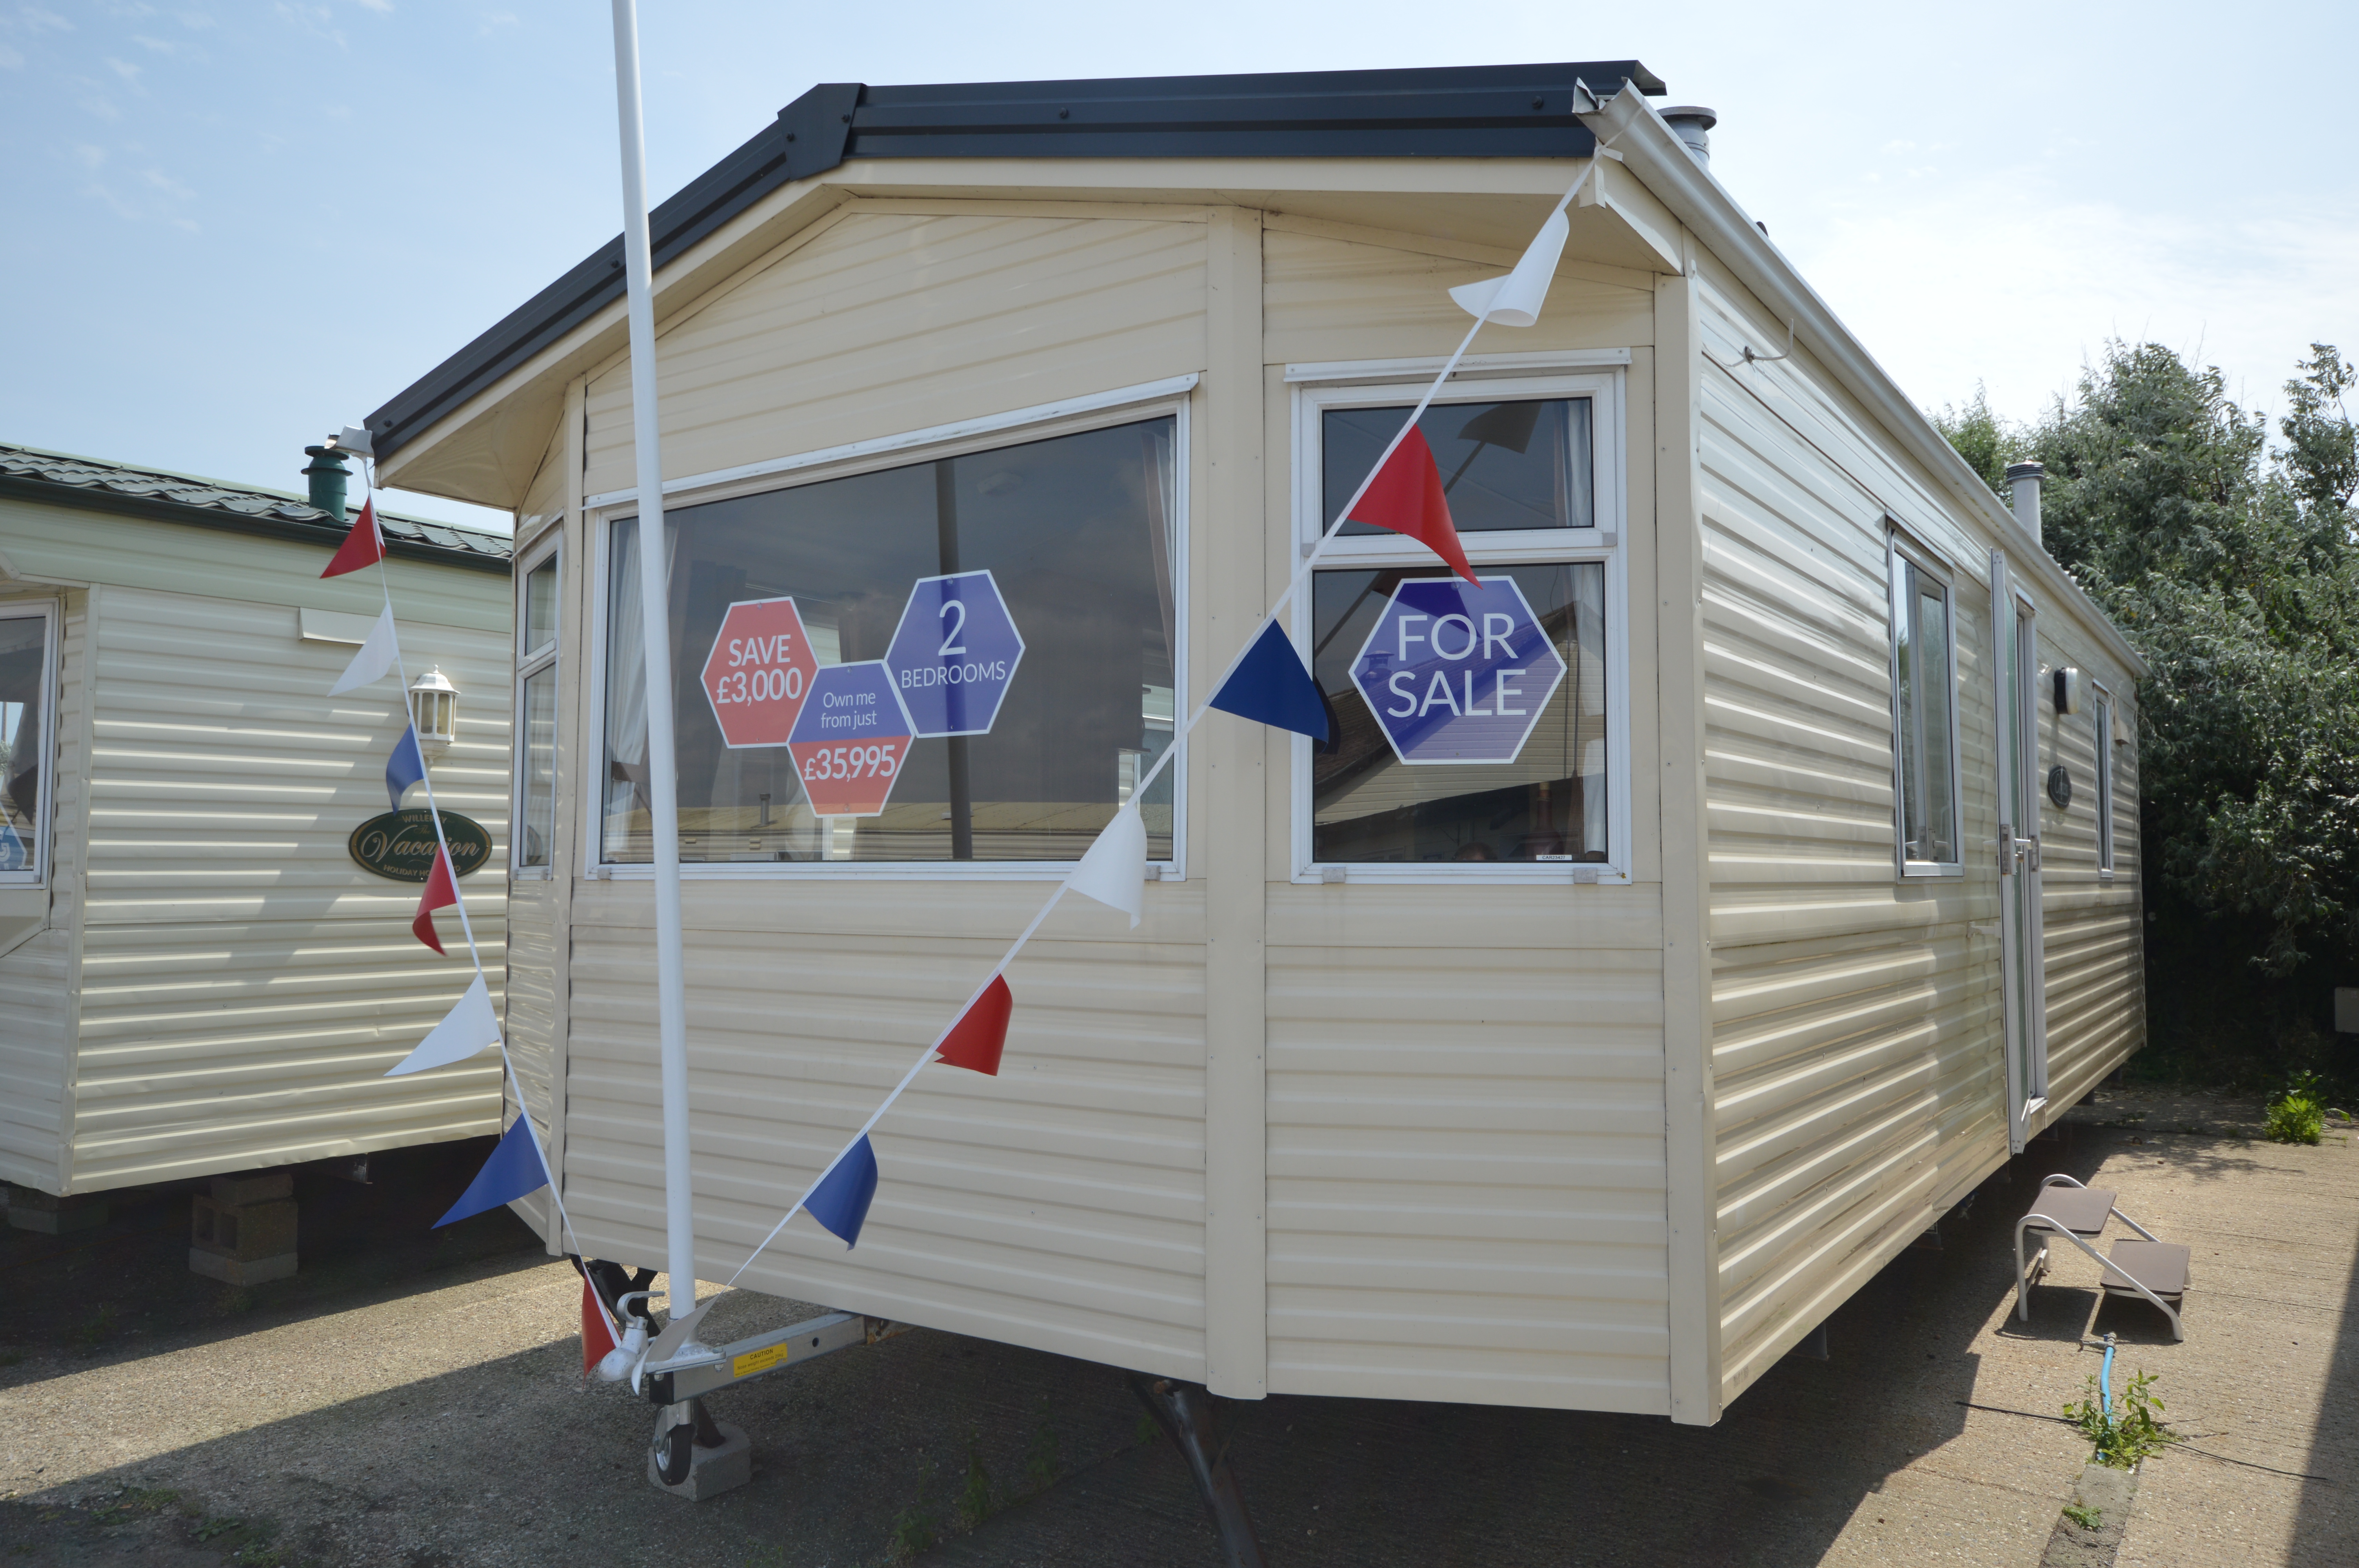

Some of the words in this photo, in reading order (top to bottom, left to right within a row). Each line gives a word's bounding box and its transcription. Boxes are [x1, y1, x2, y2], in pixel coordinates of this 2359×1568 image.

[938, 600, 966, 656] 2
[1399, 613, 1519, 661] FOR
[729, 634, 791, 666] SAVE
[717, 667, 803, 706] £3,000
[902, 661, 1006, 688] BEDROOMS
[823, 692, 853, 708] Own
[856, 693, 876, 705] me
[1387, 669, 1527, 718] SALE
[821, 713, 851, 728] from
[852, 710, 877, 730] just
[804, 745, 896, 782] £35,995
[402, 814, 447, 824] WILLERY
[383, 864, 418, 877] HOLIDAY
[750, 1348, 773, 1360] CAUTION
